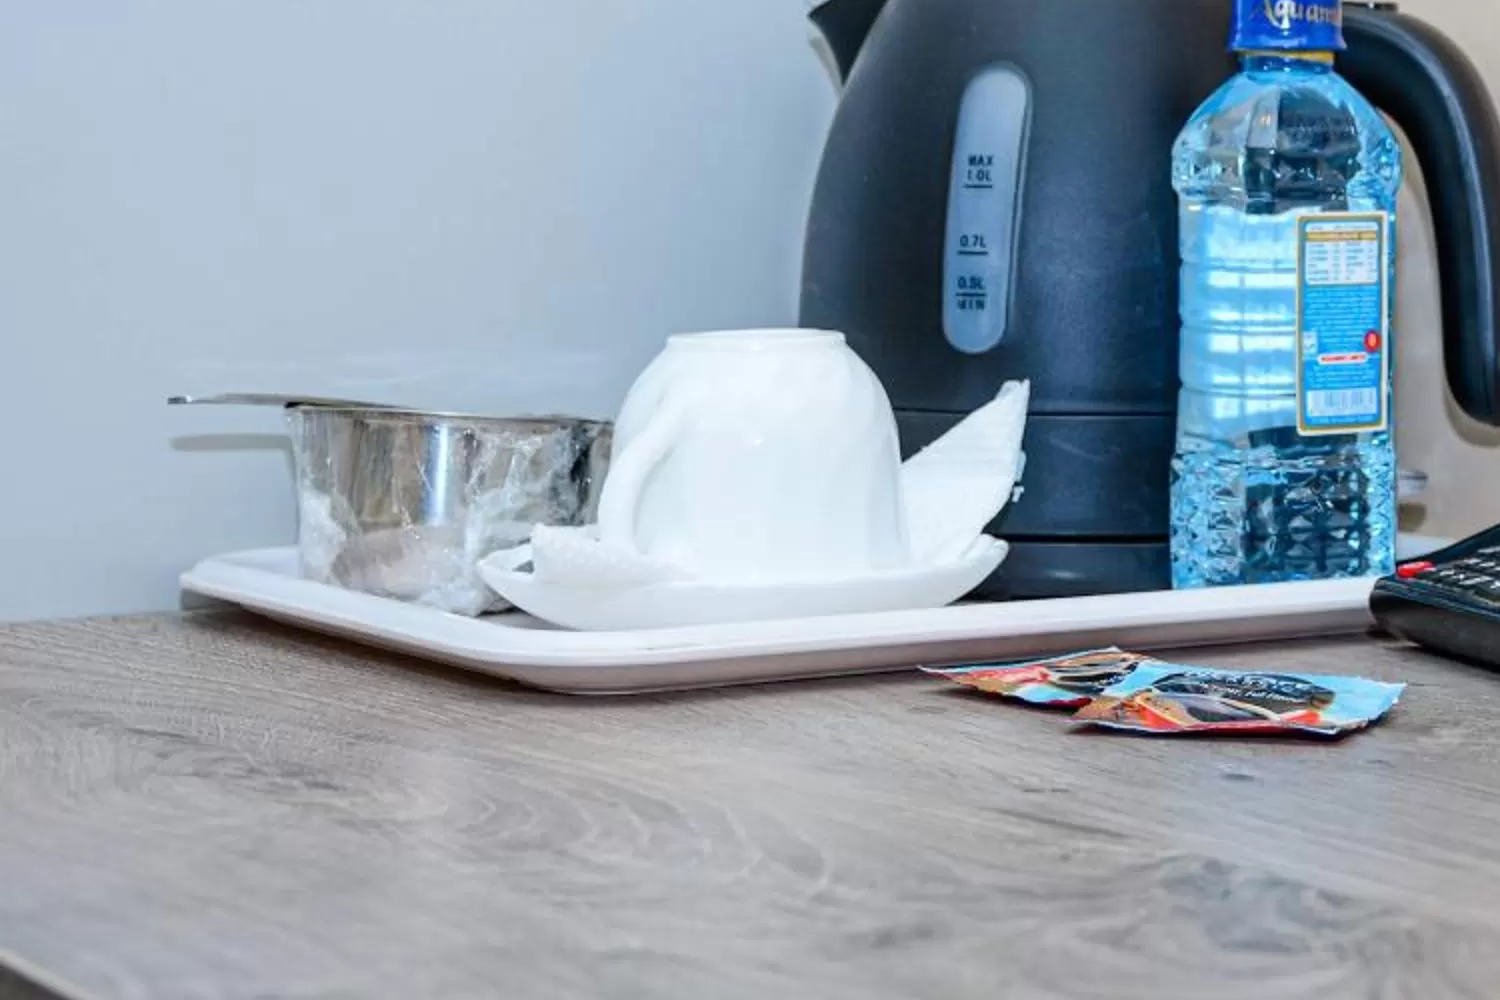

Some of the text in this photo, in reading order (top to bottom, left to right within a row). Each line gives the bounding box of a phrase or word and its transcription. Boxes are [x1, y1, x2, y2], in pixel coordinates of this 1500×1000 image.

[967, 154, 993, 166] MAX
[959, 234, 986, 248] 0.7L
[957, 299, 985, 310] MIN
